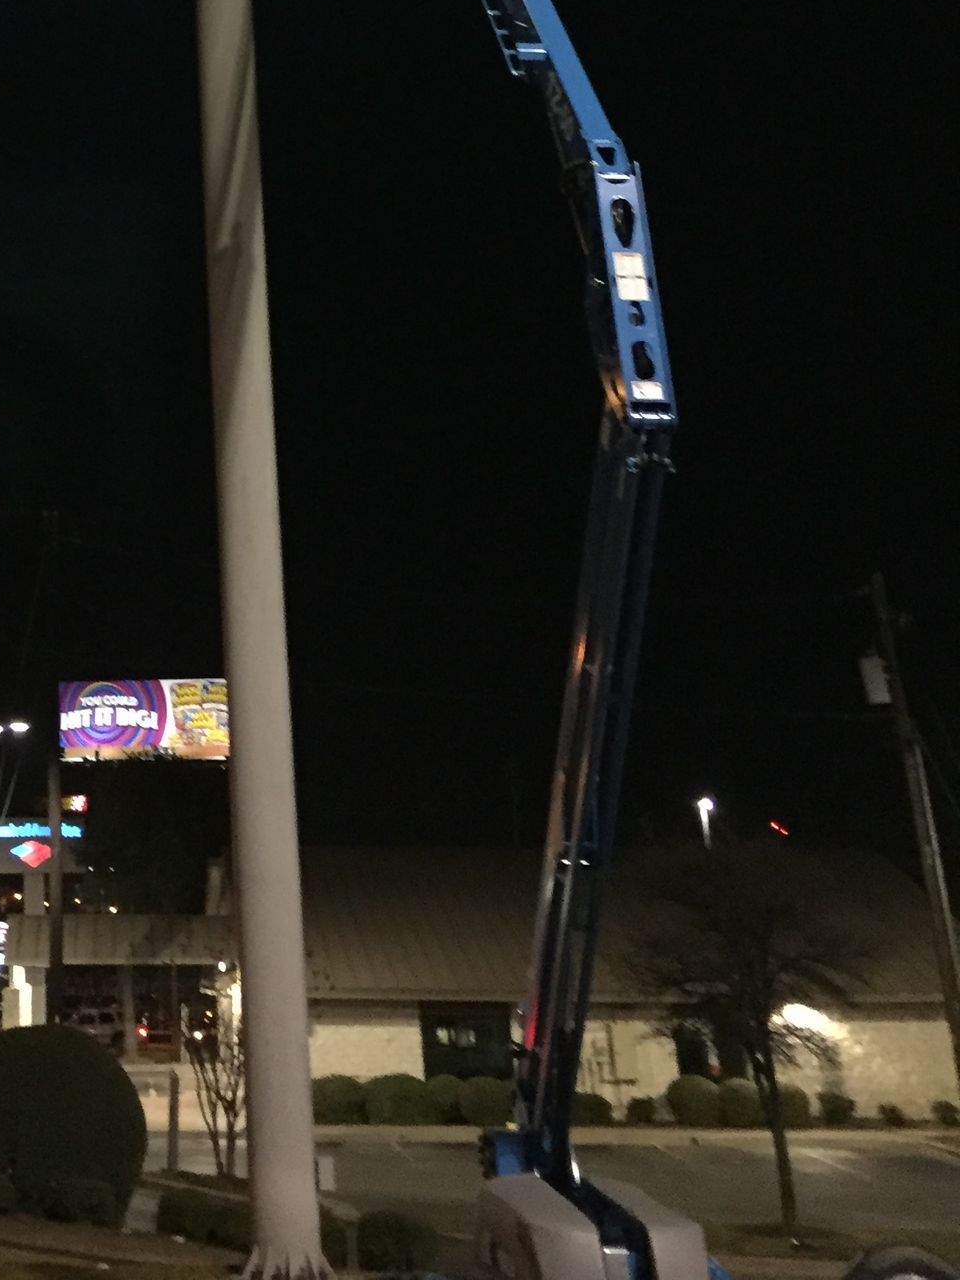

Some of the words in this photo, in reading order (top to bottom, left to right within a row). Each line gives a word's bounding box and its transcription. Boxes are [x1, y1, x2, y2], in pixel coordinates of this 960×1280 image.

[80, 696, 101, 707] YOU
[103, 695, 139, 707] COULD
[60, 709, 92, 730] HIT
[94, 707, 114, 727] IT
